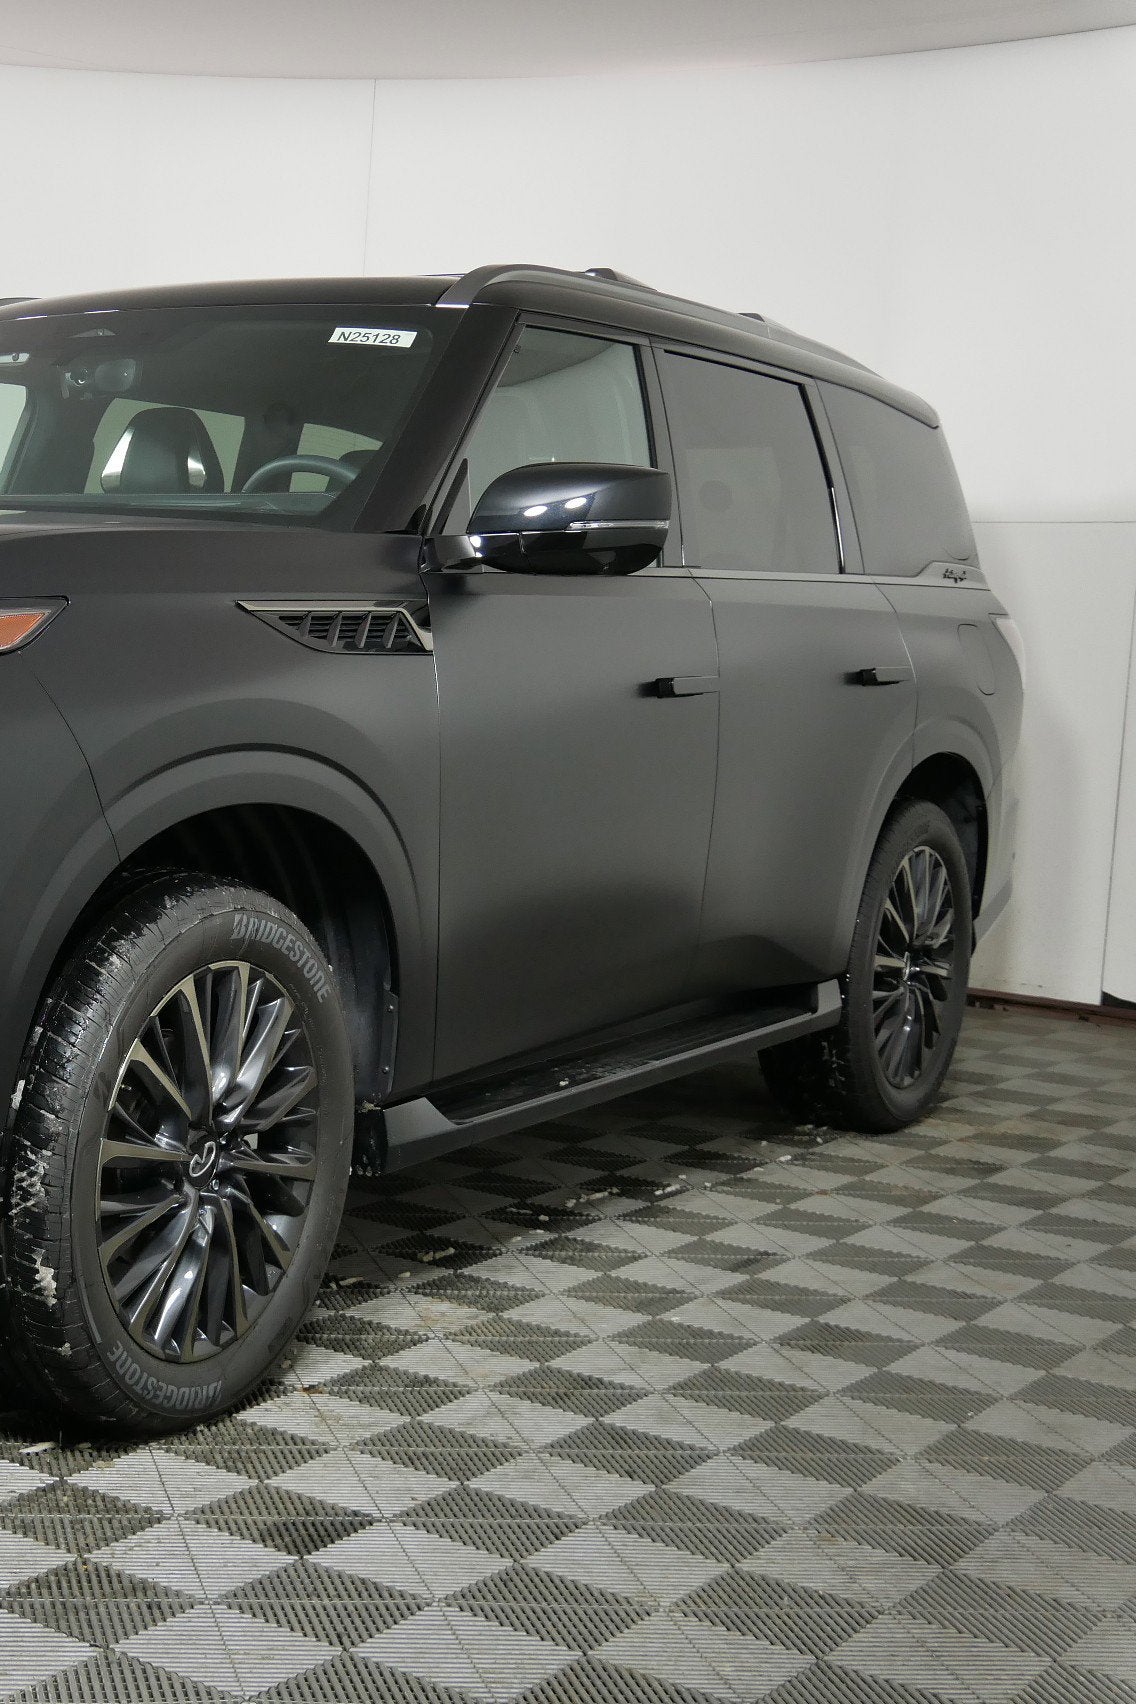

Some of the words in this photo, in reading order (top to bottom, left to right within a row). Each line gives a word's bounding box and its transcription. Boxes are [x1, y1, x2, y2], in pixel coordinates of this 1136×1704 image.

[337, 331, 400, 344] N25128
[231, 912, 331, 1003] BRIDGESTONE
[107, 1340, 222, 1409] BRIDGESTONE
